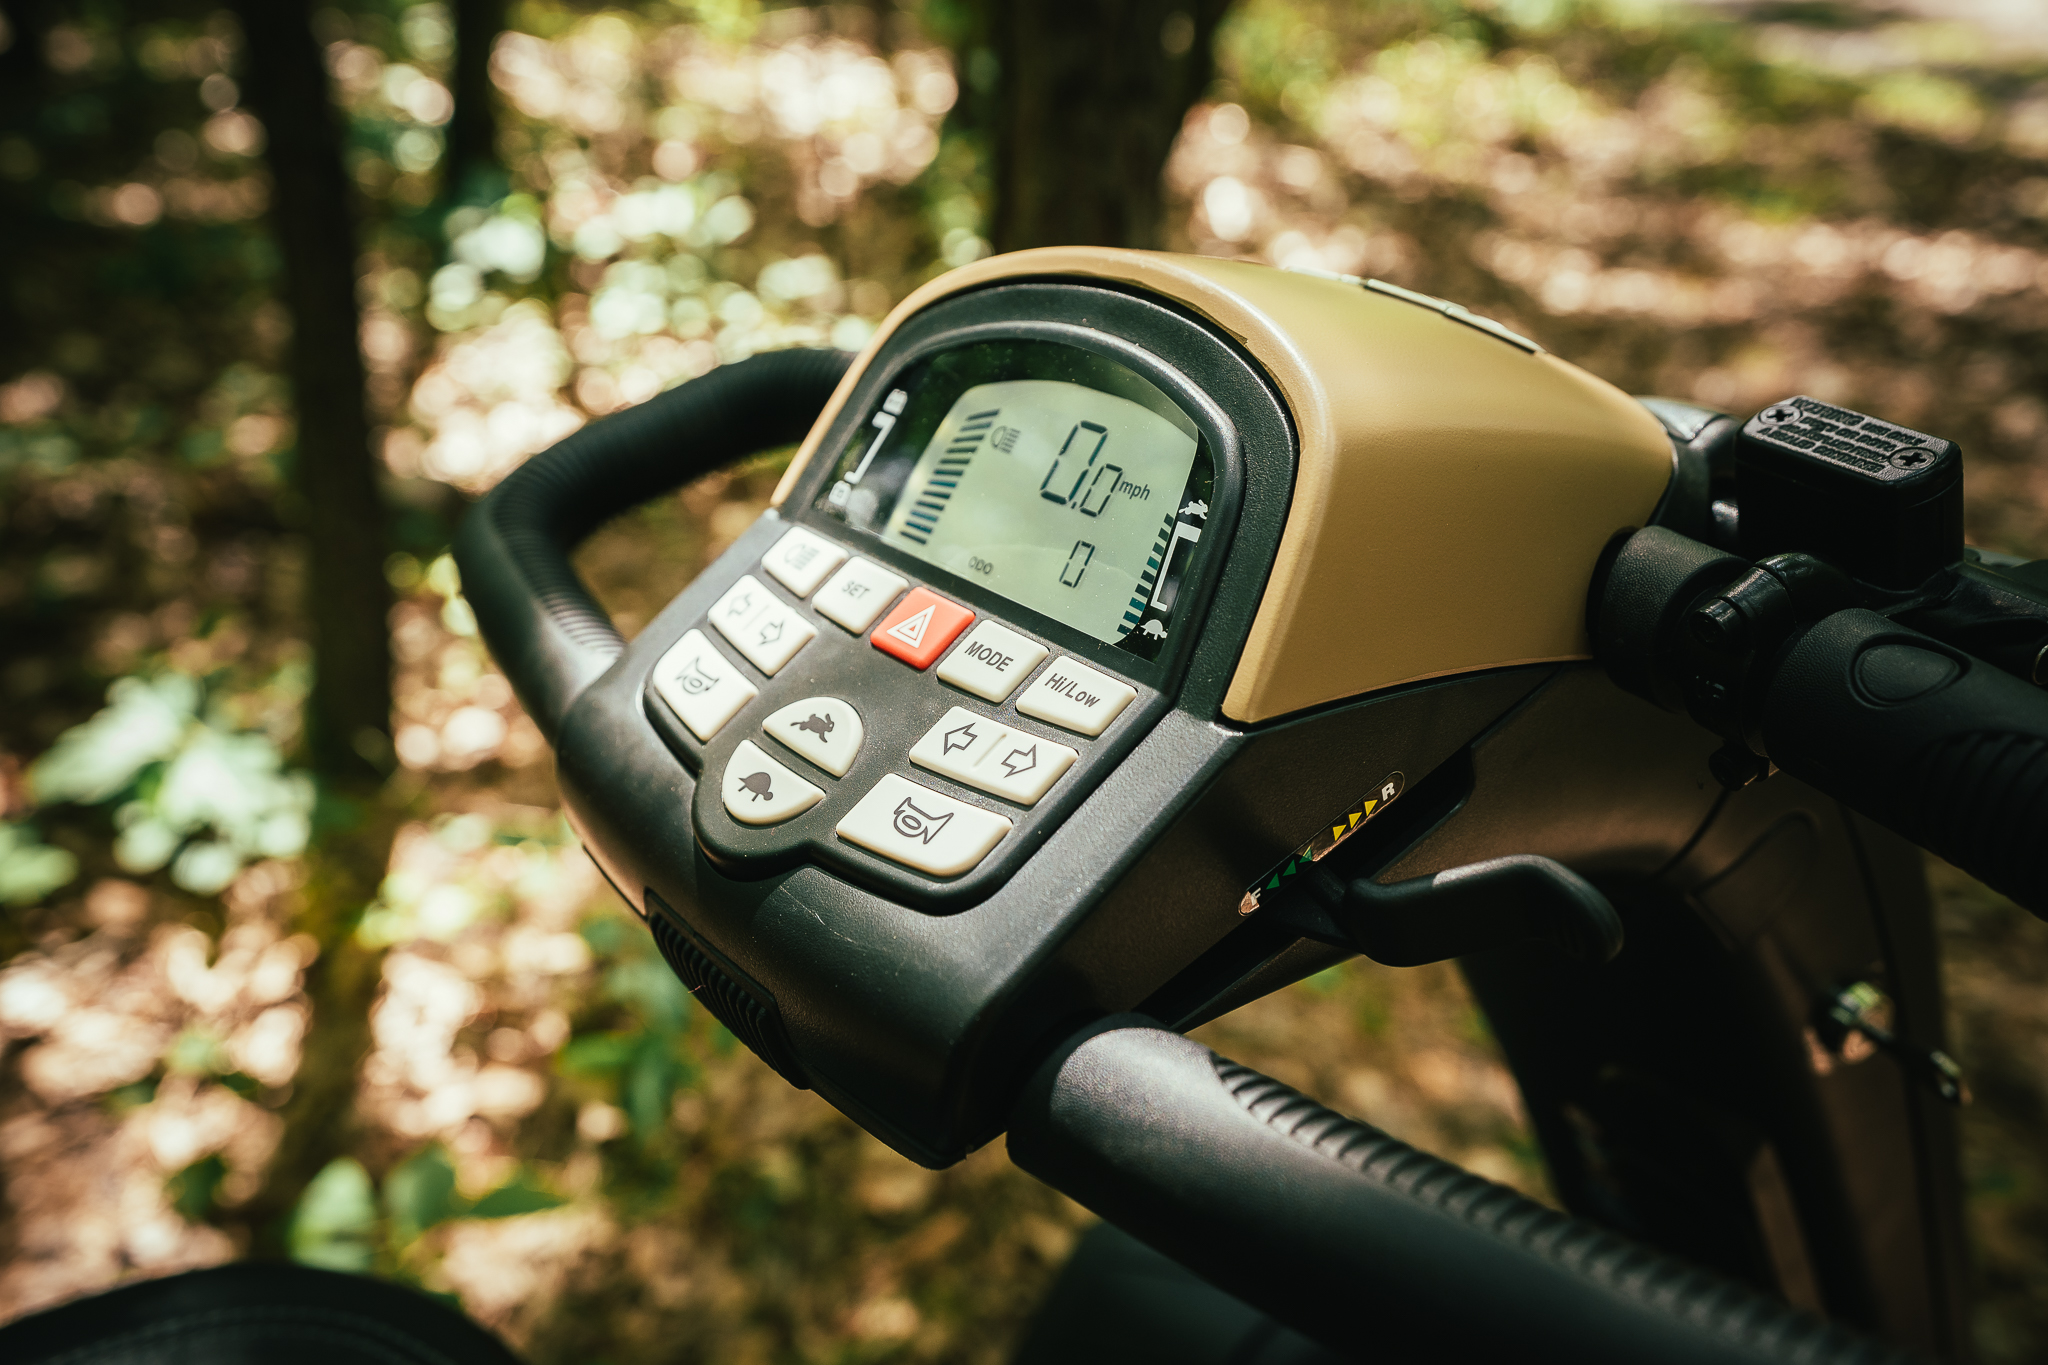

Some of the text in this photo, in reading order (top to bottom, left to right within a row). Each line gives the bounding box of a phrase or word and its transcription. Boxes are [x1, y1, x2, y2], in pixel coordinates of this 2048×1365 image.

[1119, 480, 1150, 501] mph
[968, 556, 994, 575] ODO
[1059, 540, 1095, 588] 0
[842, 580, 870, 599] SET
[964, 641, 1014, 672] MODE
[1381, 782, 1395, 801] R
[1250, 887, 1262, 906] F
